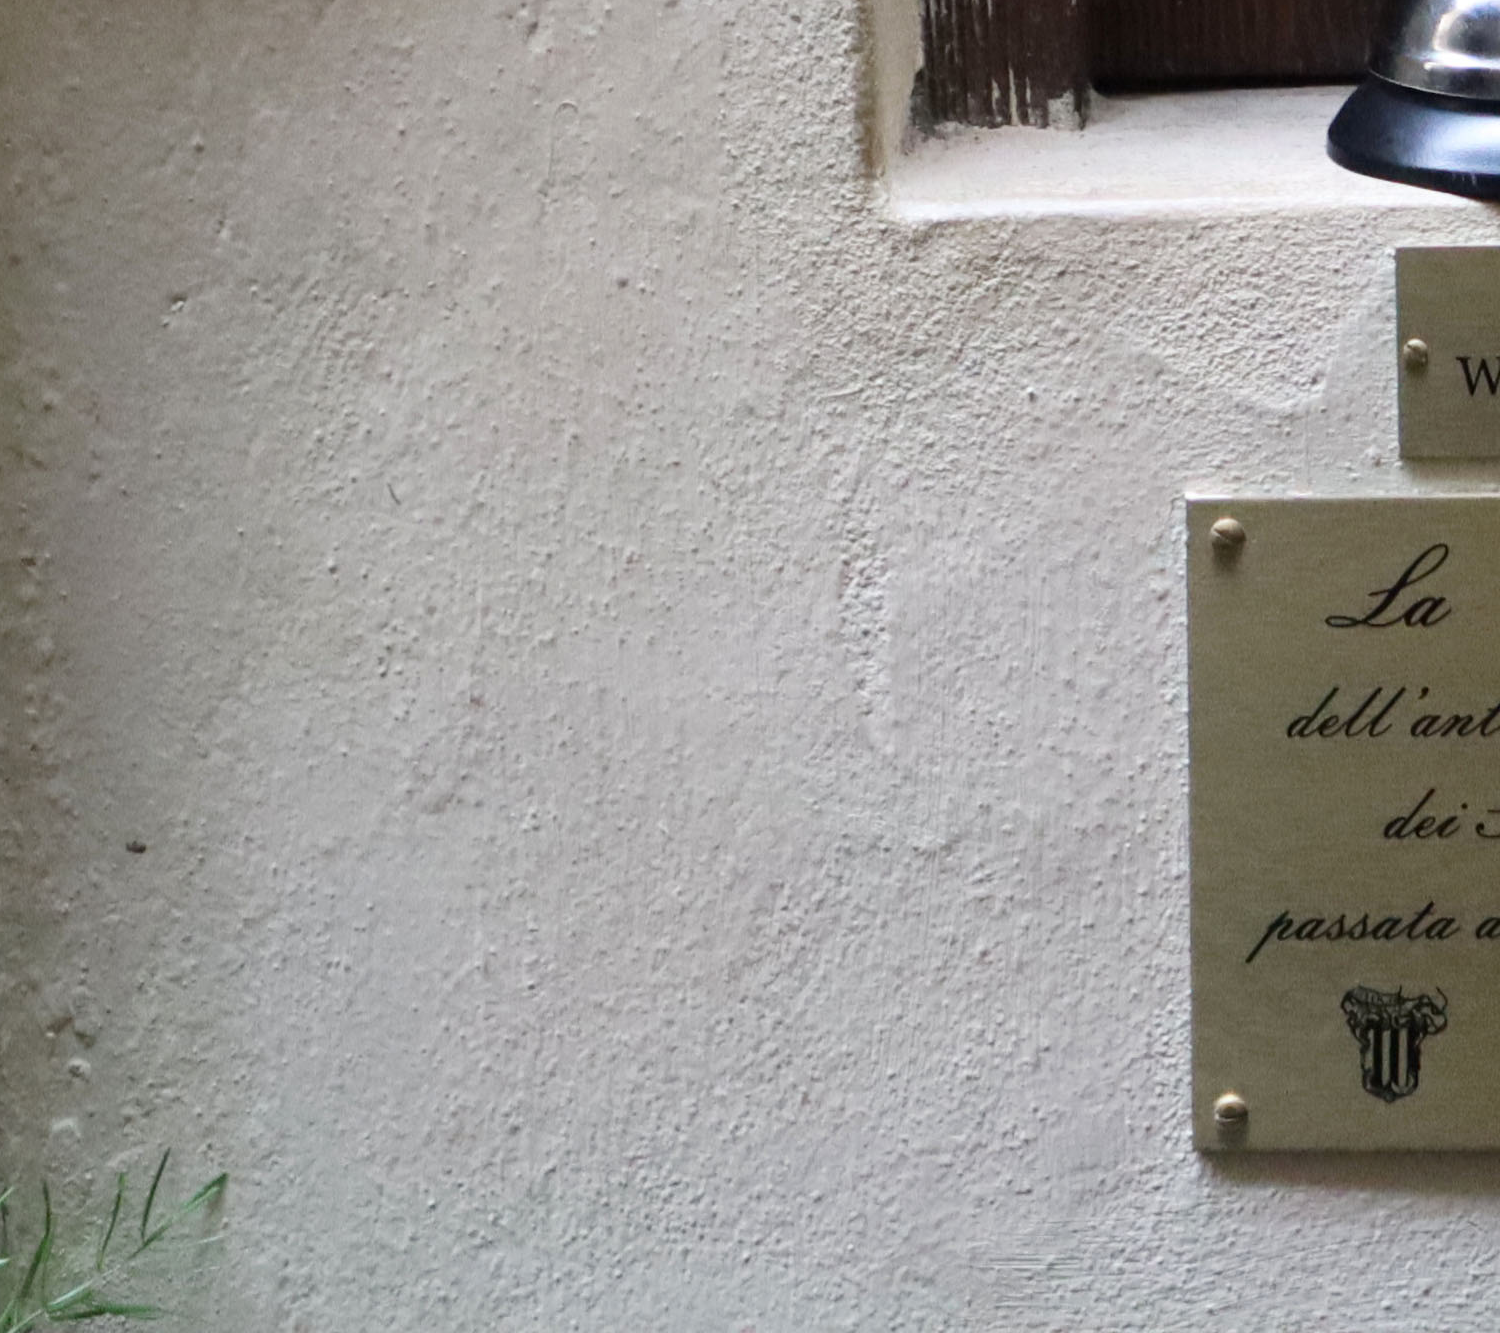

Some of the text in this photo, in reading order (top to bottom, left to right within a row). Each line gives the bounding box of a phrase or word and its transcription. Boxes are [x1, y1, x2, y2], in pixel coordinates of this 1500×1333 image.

[1324, 542, 1453, 628] La
[1383, 787, 1469, 840] dei
[1244, 900, 1461, 964] passata
